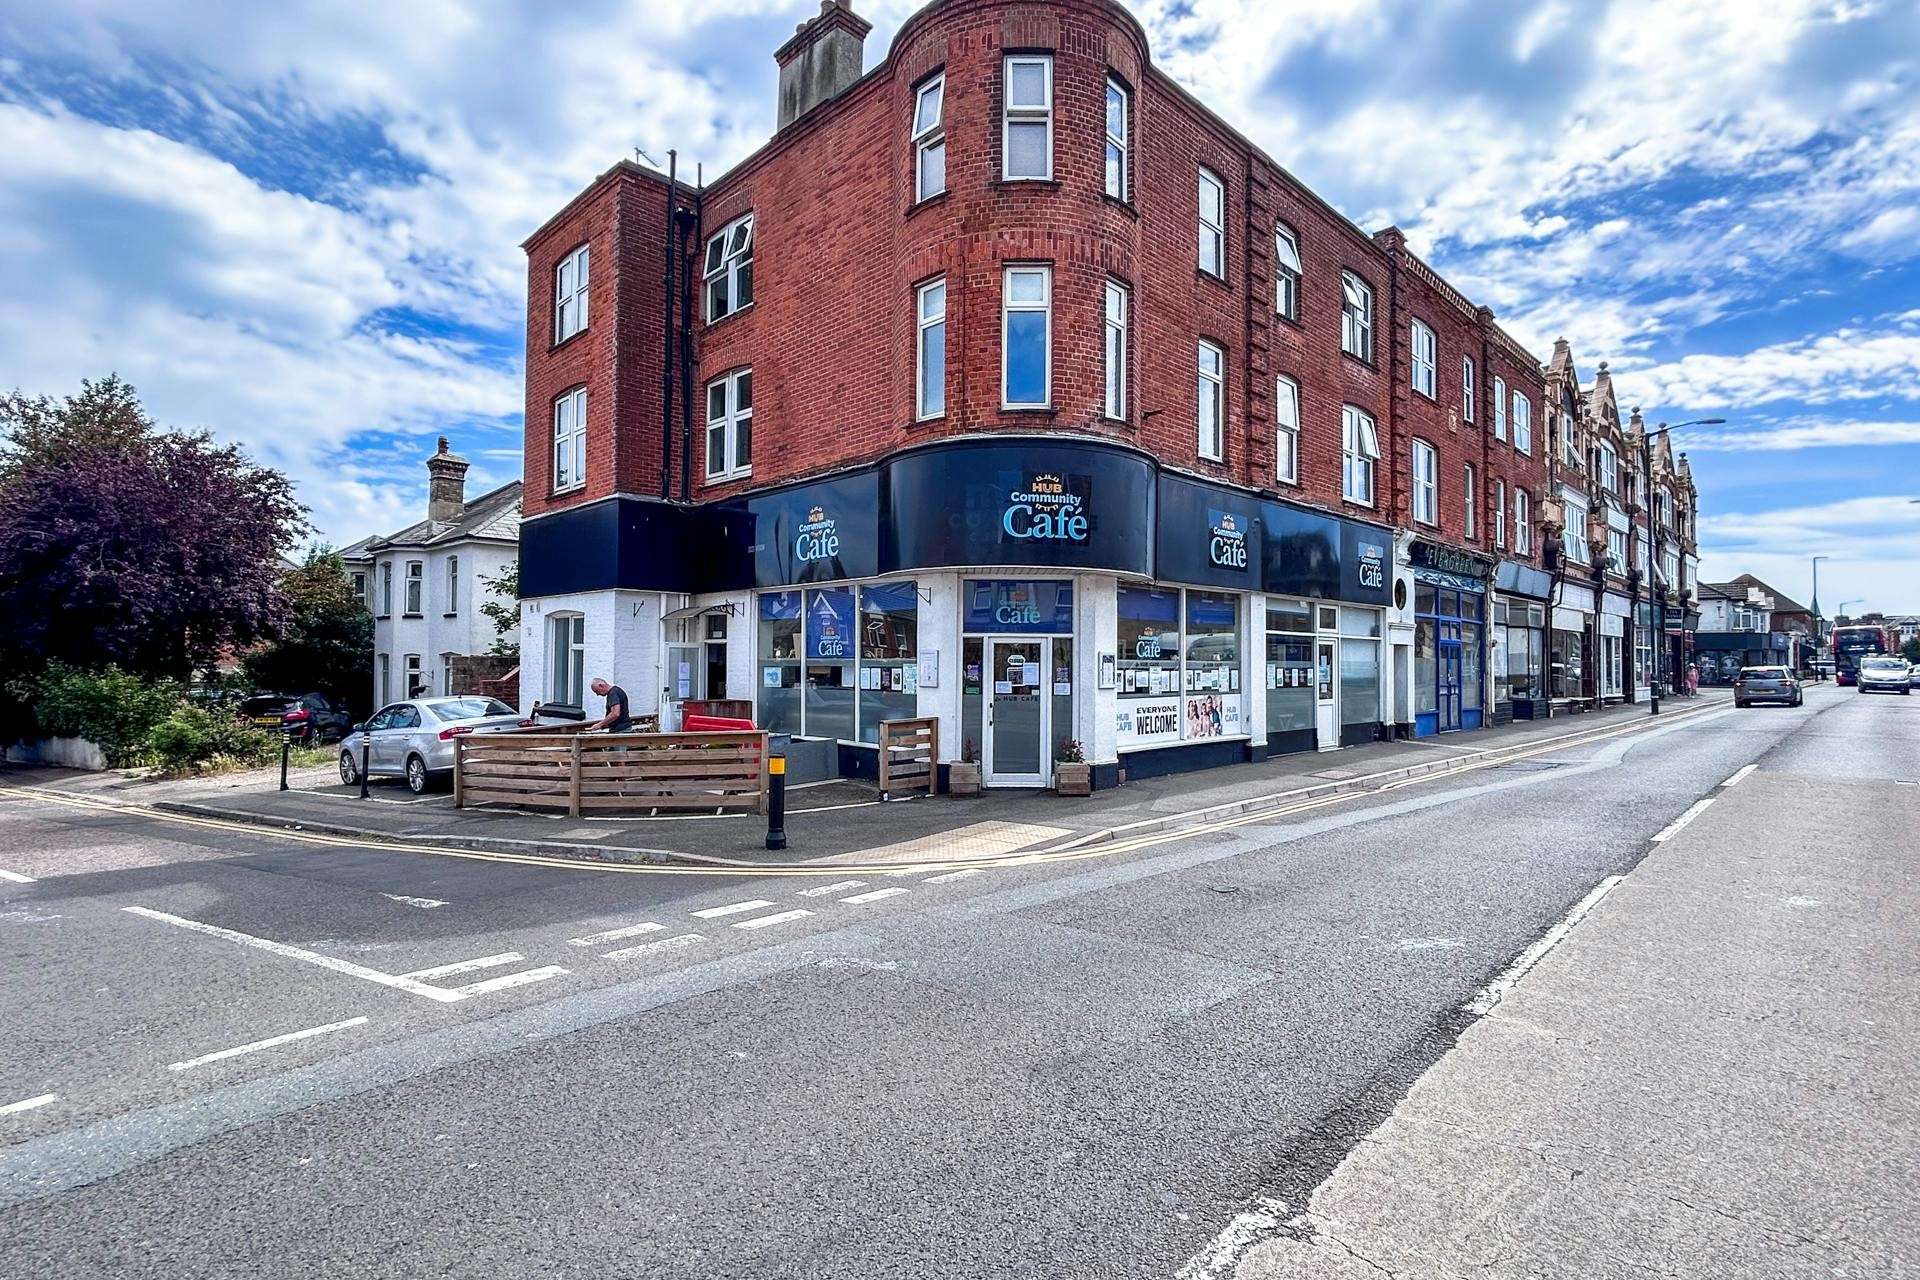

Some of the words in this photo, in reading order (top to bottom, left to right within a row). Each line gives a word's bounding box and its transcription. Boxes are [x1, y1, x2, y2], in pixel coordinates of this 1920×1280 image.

[1032, 482, 1062, 493] HUB
[1011, 491, 1081, 506] Community
[798, 519, 835, 533] Community
[1003, 504, 1088, 540] Café
[1222, 520, 1235, 530] HUB
[1213, 526, 1245, 541] Community
[796, 528, 839, 561] Café
[1210, 536, 1247, 568] Café
[1359, 563, 1383, 588] Café
[995, 604, 1041, 624] Café
[818, 639, 843, 656] Café
[1136, 640, 1161, 658] Café
[1136, 705, 1177, 714] EVERYONE
[1136, 714, 1178, 736] WELCOME
